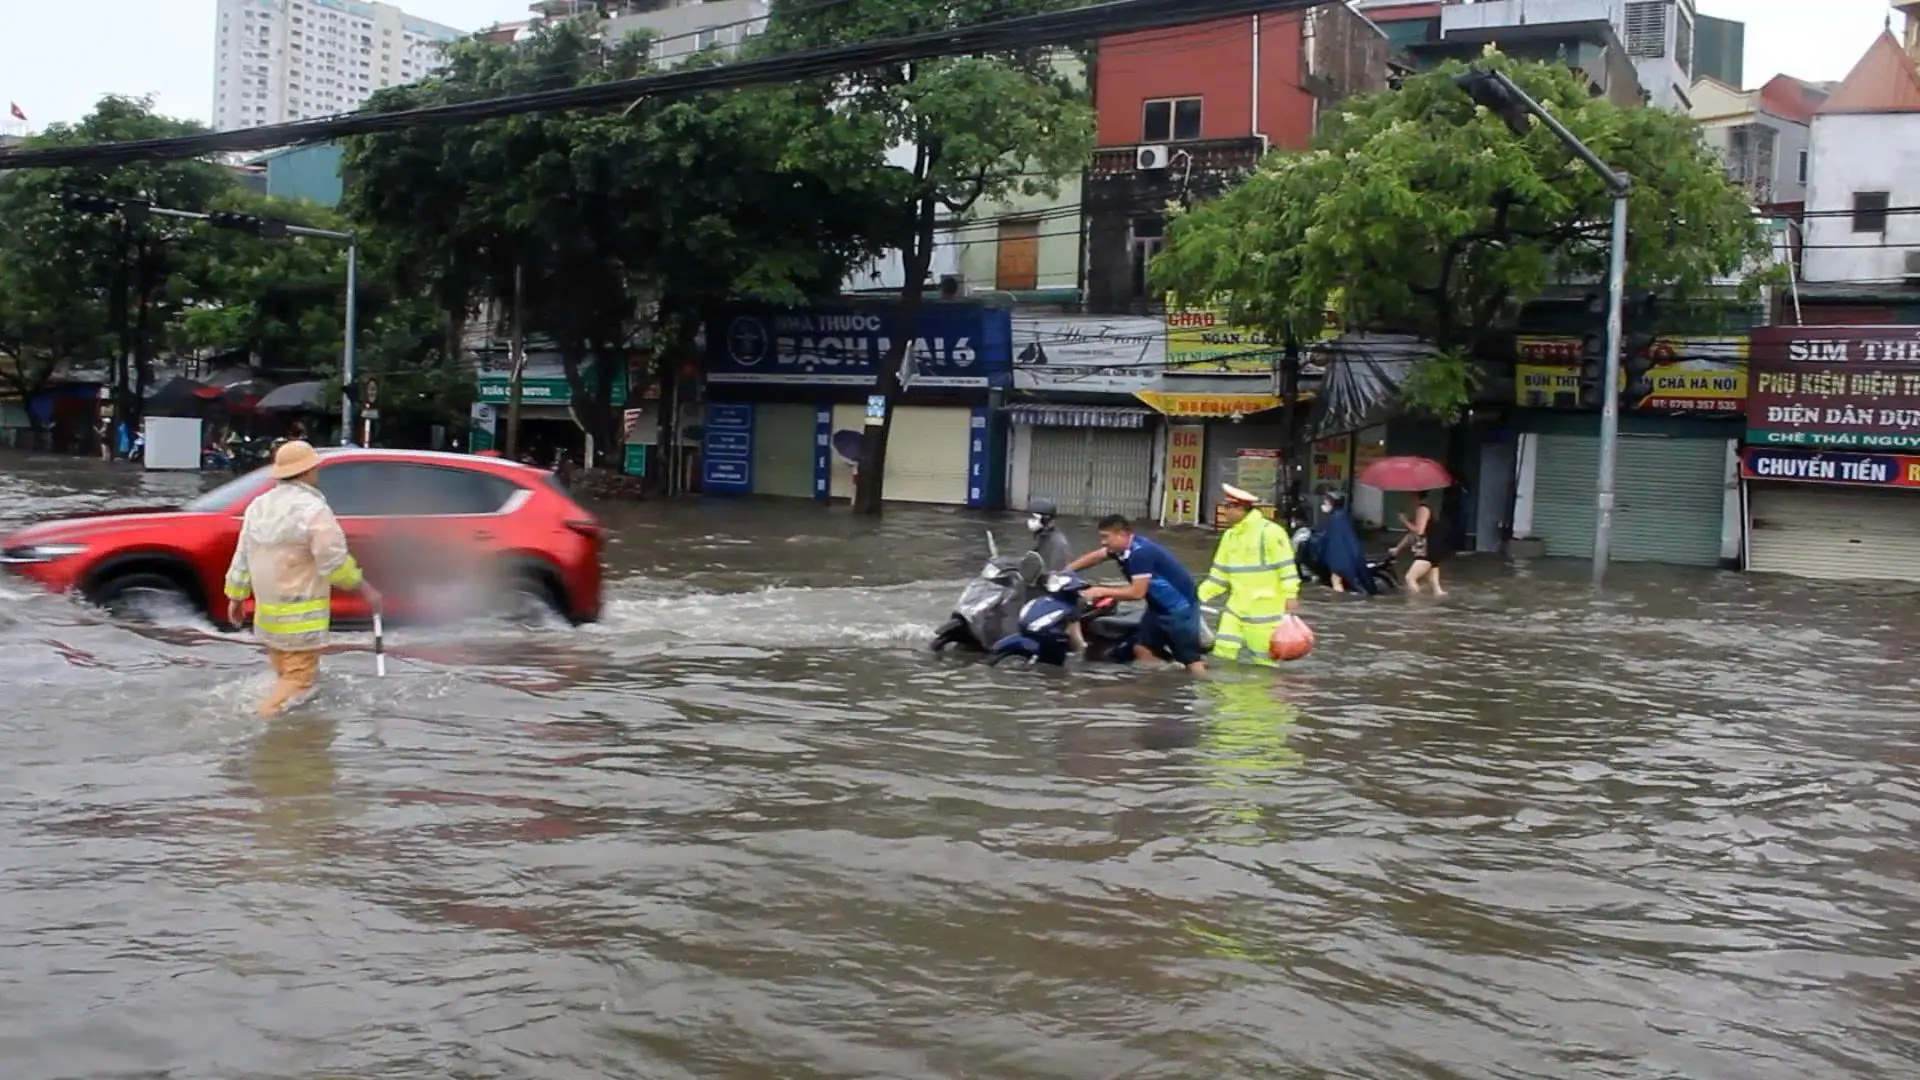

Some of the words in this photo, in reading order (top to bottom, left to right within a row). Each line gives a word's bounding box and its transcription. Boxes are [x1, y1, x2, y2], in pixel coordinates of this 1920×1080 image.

[952, 337, 976, 368] 6
[1789, 339, 1849, 362] SIM
[1767, 403, 1820, 427] ĐIỆN
[1825, 404, 1874, 425] DÂN
